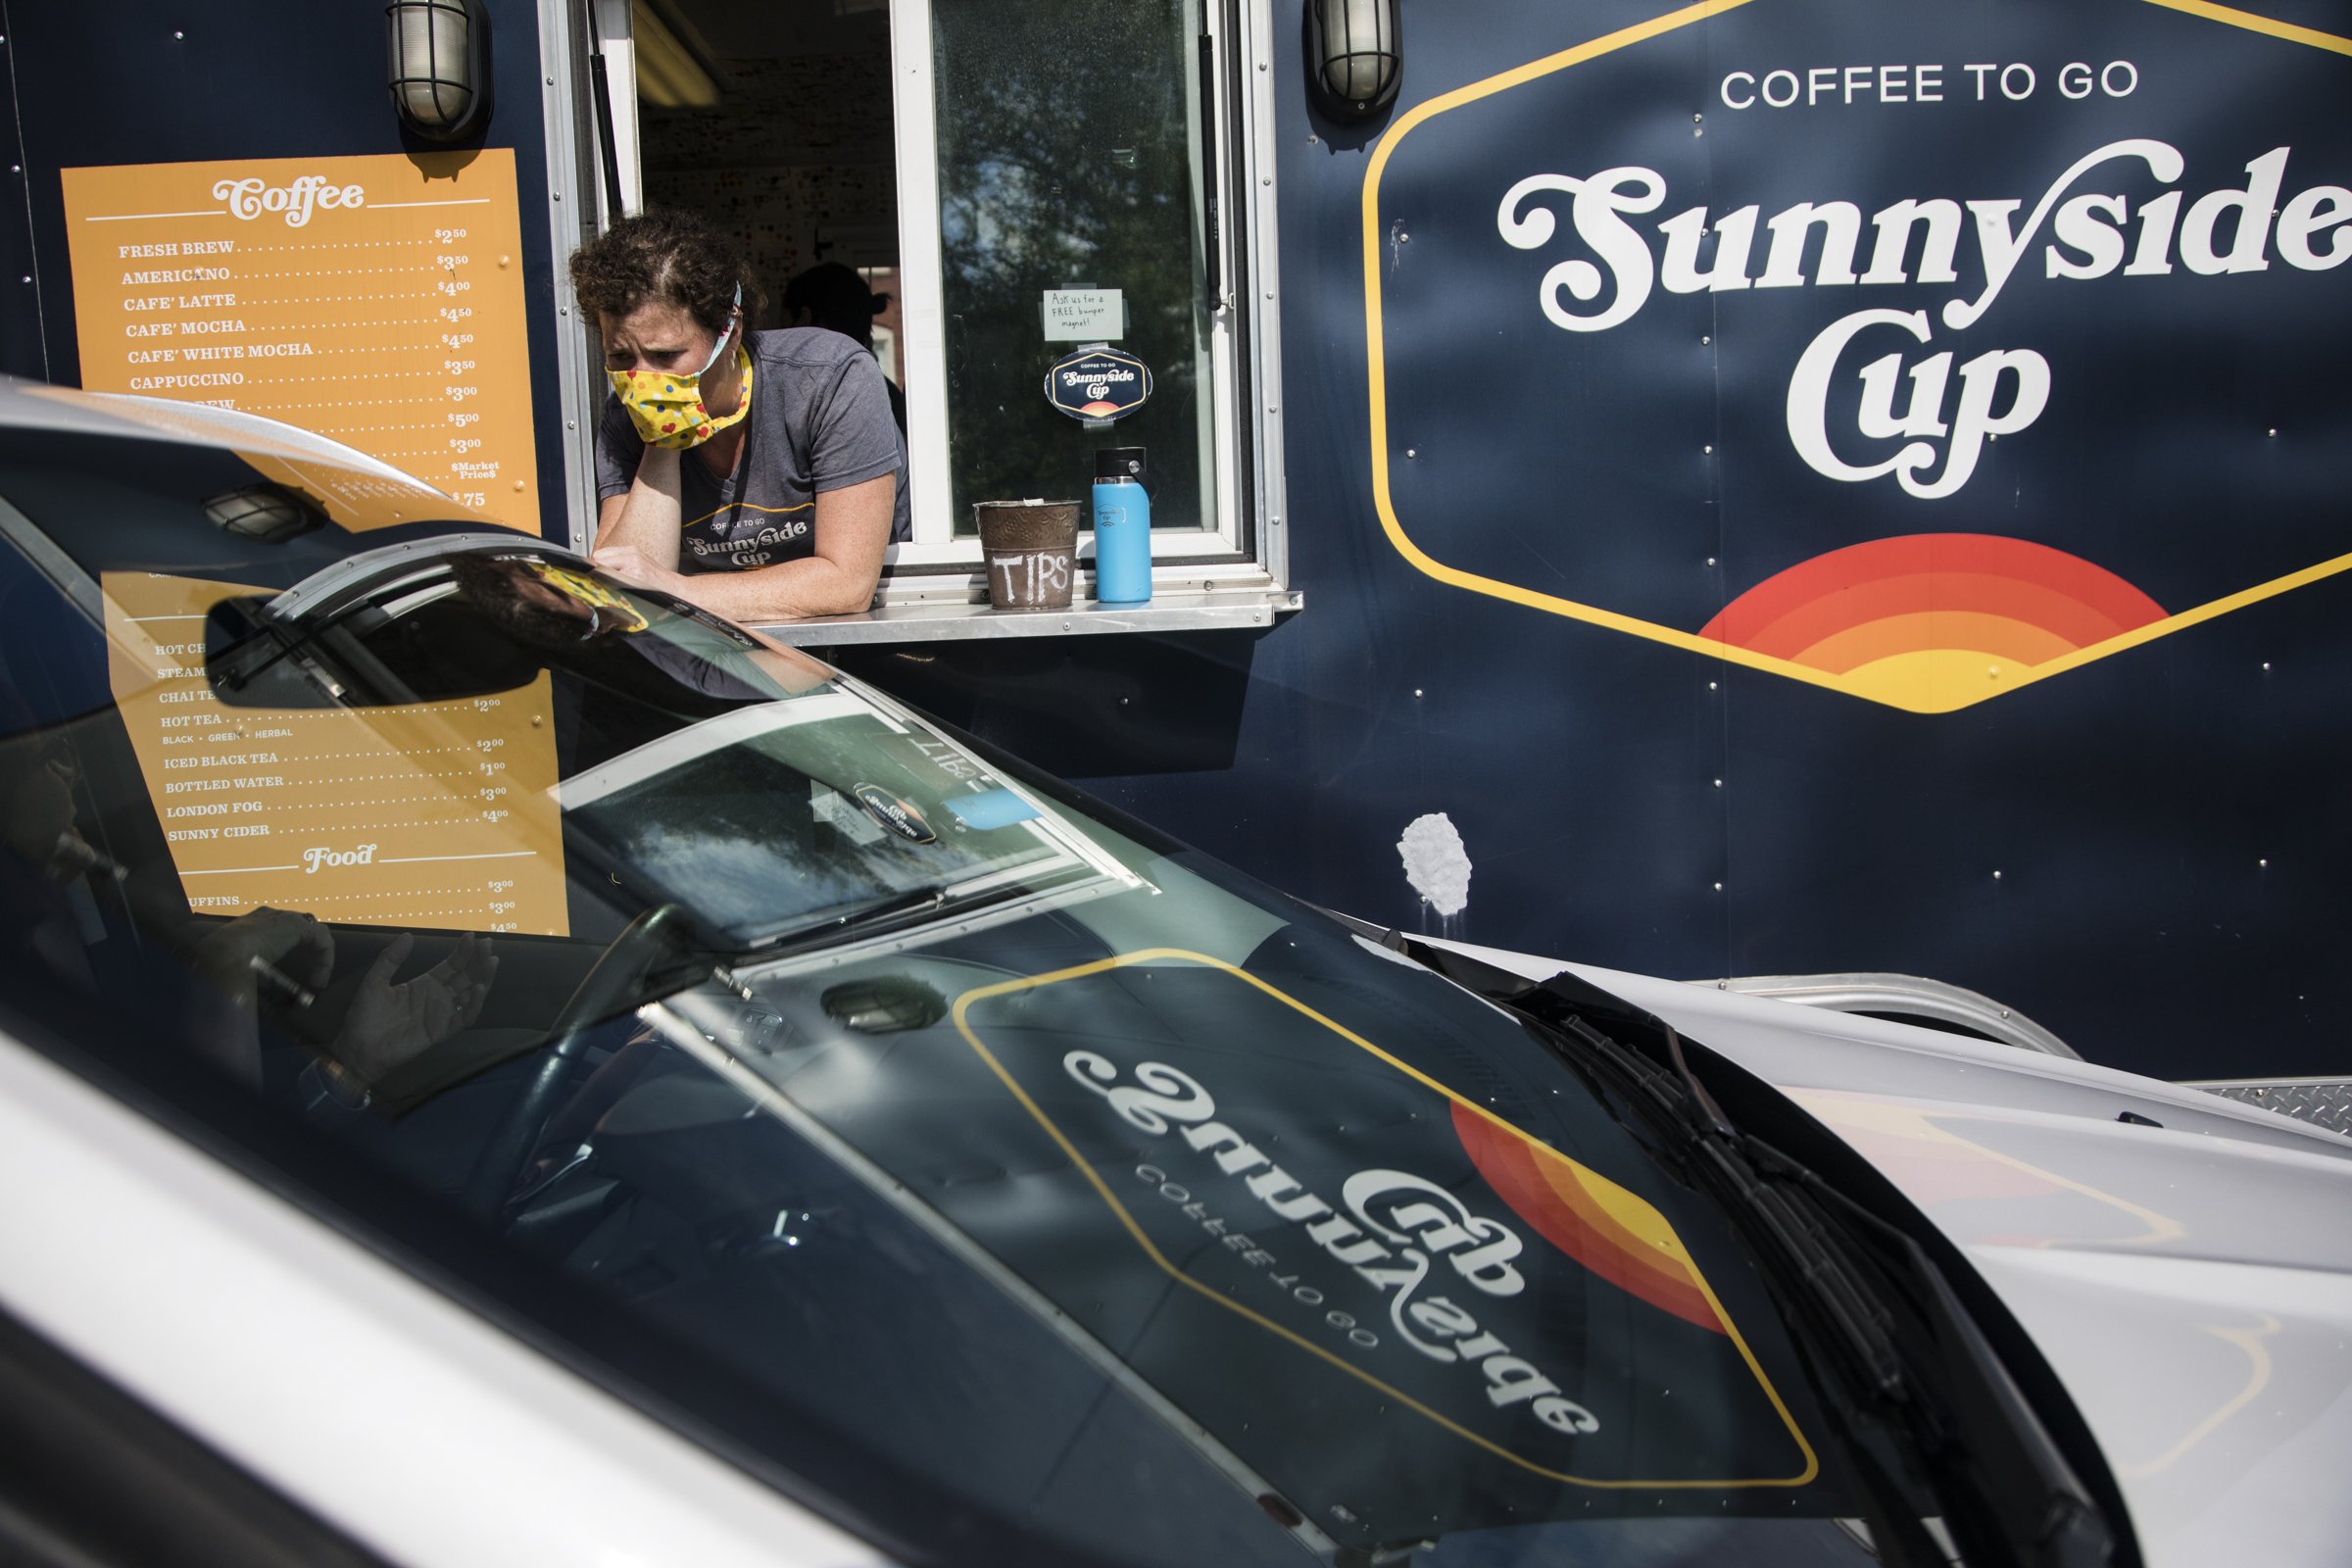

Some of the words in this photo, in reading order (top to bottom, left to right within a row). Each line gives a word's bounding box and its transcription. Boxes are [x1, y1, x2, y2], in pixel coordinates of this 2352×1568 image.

[1720, 65, 1944, 110] COFFEE
[1964, 63, 2037, 103] TO
[2057, 60, 2139, 100] GO
[213, 175, 365, 227] Coffee
[1497, 138, 2352, 332] Sunnyside
[119, 244, 178, 259] FRESH
[182, 240, 235, 255] BREW
[122, 268, 230, 285] AMERICANO
[179, 294, 236, 309] LATTE
[1053, 293, 1068, 305] Ask
[1084, 294, 1095, 303] for
[1052, 307, 1074, 317] FREE
[1078, 307, 1105, 318] bumper
[181, 319, 247, 335] MOCHA
[1061, 318, 1091, 329] magnet!
[183, 346, 244, 362] WHITE
[248, 343, 314, 358] MOCHA
[129, 372, 244, 390] CAPPUCCINO
[1062, 368, 1135, 387] Sunnyside
[1086, 383, 1110, 400] Cup
[1786, 308, 2051, 500] Cup
[451, 461, 500, 472] $Market
[460, 470, 497, 479] Price$
[688, 521, 808, 556] Sunnyside
[731, 551, 772, 565] Cup
[992, 552, 1068, 604] TIPS
[156, 644, 184, 656] HOT
[159, 691, 195, 704] CHAI
[197, 690, 219, 702] TE
[161, 715, 190, 727] HOT
[194, 713, 221, 725] TEA
[163, 735, 194, 745] BLACK
[208, 732, 241, 742] GREEN
[255, 728, 293, 738] HERBAL
[165, 759, 197, 769] ICED
[201, 755, 247, 767] BLACK
[250, 753, 278, 764] TEA
[166, 780, 230, 794] BOTTLED
[233, 776, 284, 789] WATER
[167, 804, 227, 818] LONDON
[232, 802, 263, 812] FOG
[168, 828, 220, 841] SUNNY
[223, 825, 270, 838] CIDER
[303, 844, 377, 874] Food
[189, 896, 240, 907] UFFINS
